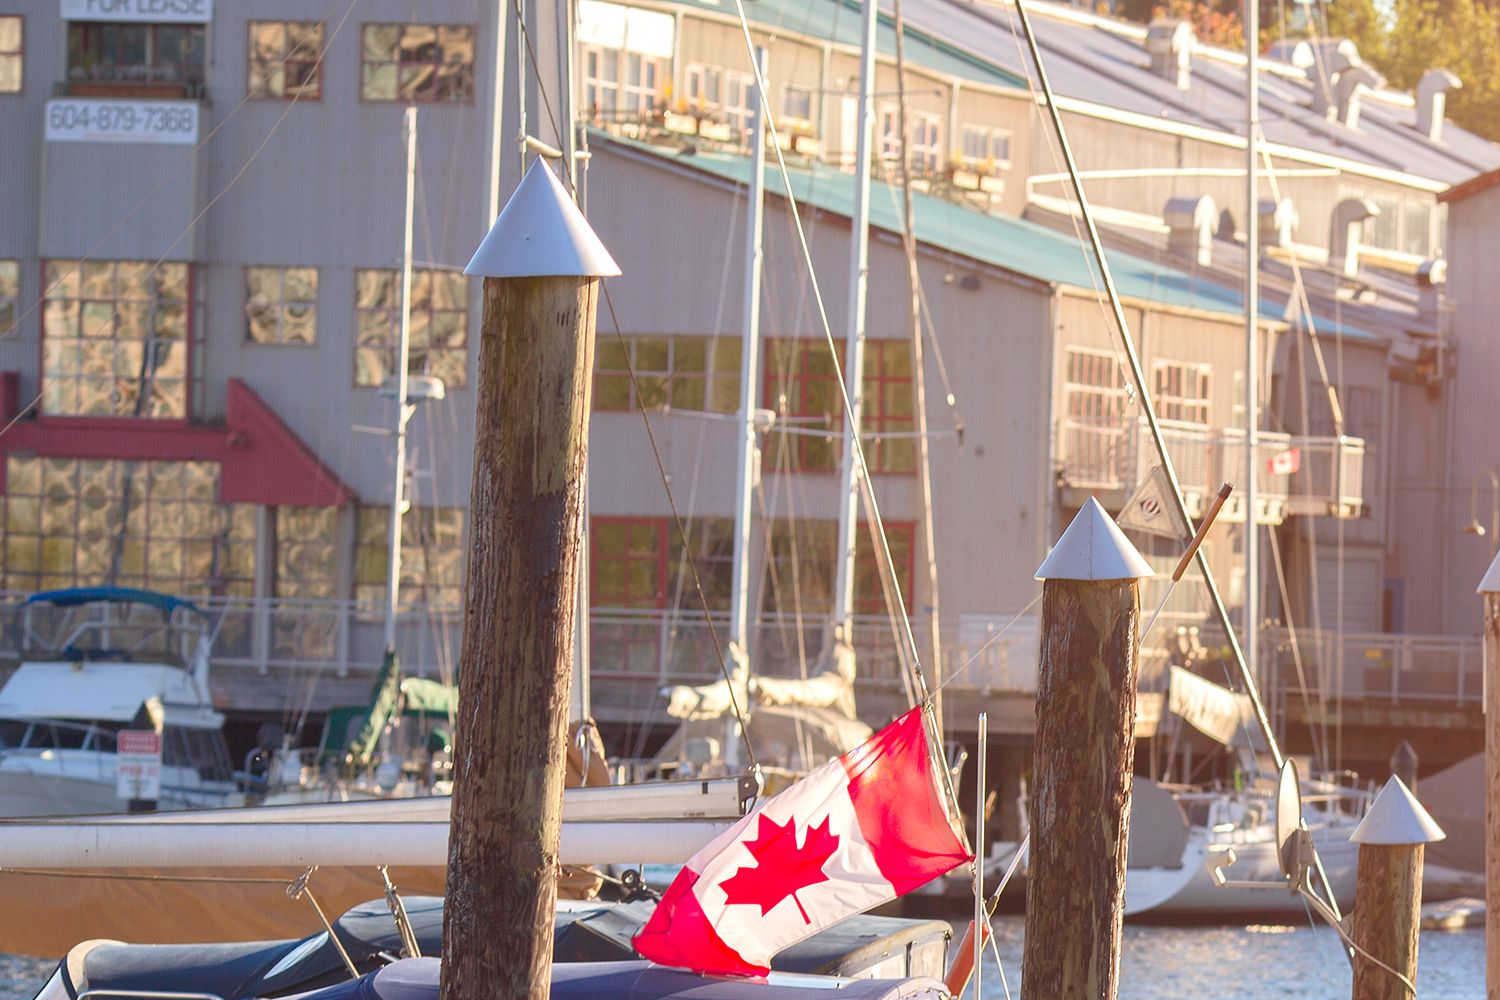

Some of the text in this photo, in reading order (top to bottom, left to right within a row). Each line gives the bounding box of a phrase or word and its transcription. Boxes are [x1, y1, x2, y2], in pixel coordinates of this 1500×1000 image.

[85, 0, 206, 15] FOR LEASE
[50, 104, 193, 132] 604-879-7368
